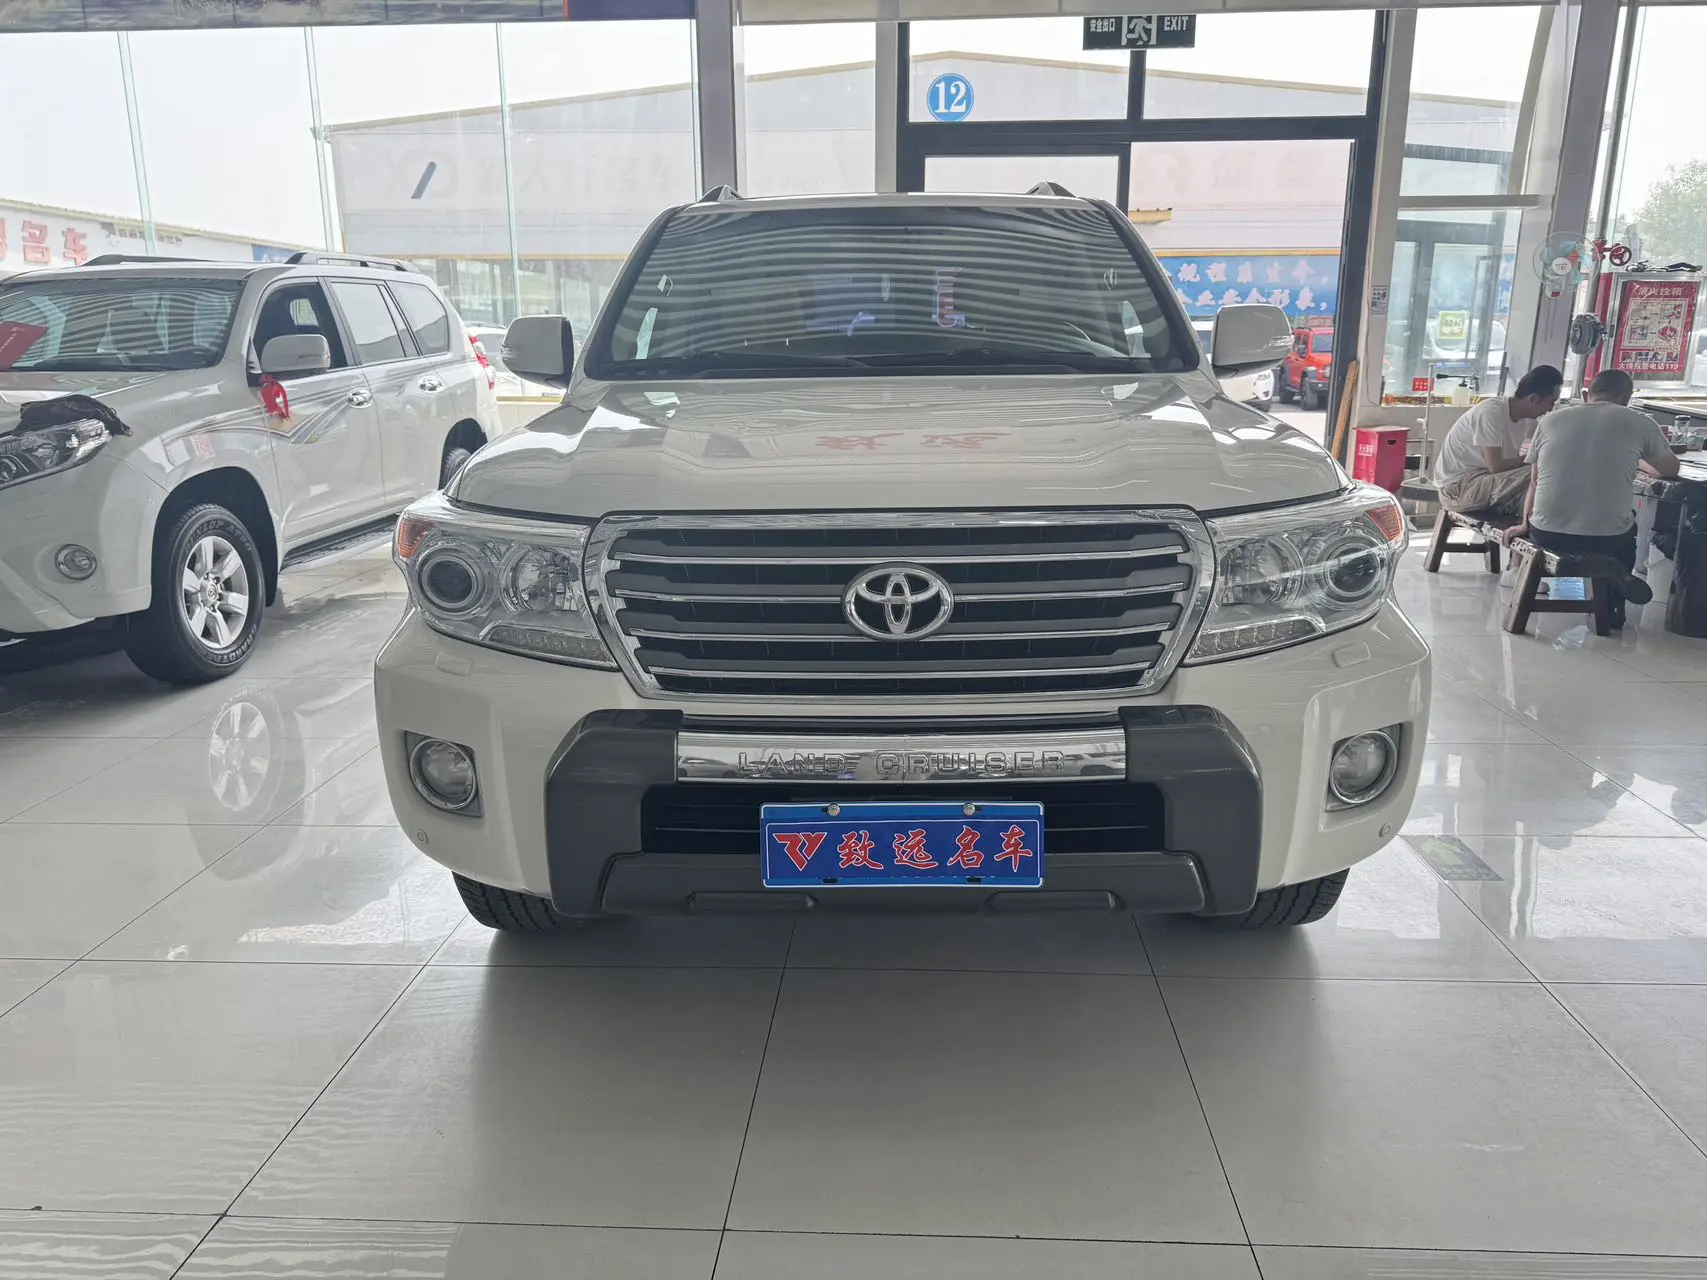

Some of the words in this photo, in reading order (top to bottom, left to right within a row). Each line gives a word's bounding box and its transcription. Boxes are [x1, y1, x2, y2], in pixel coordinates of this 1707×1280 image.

[1090, 18, 1116, 32] 安全出口
[1163, 16, 1189, 31] EXIT
[934, 81, 967, 113] 12
[0, 217, 88, 267] 名车
[738, 751, 847, 775] LAND
[874, 750, 1066, 775] CRUISER
[836, 824, 1033, 873] 致远名车
